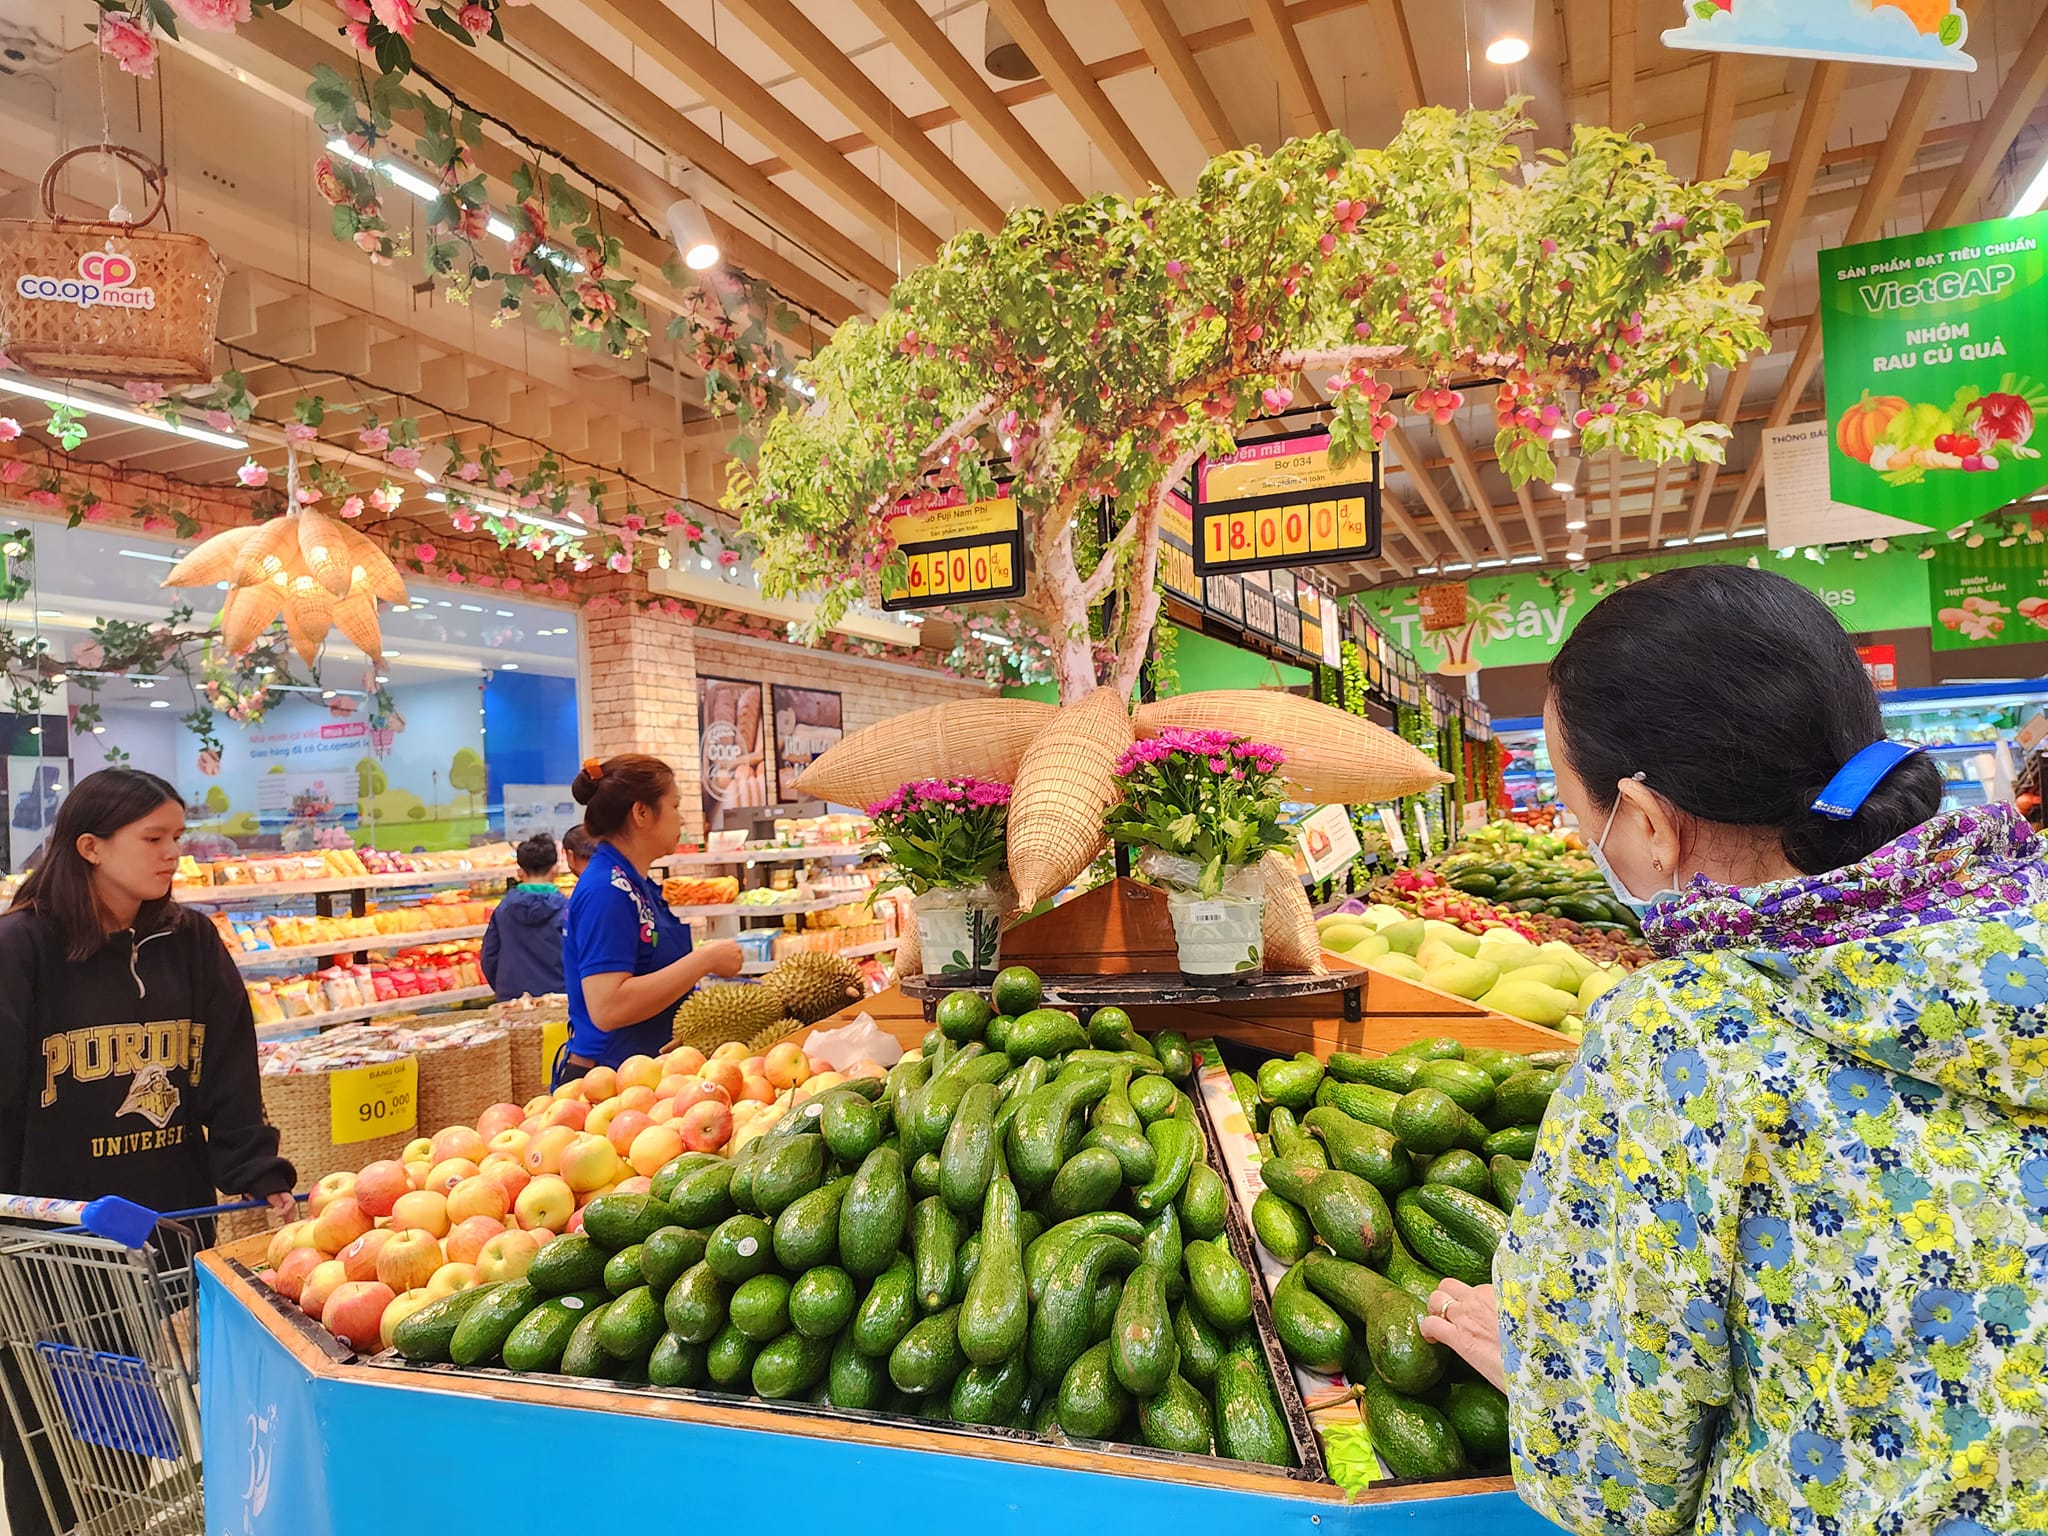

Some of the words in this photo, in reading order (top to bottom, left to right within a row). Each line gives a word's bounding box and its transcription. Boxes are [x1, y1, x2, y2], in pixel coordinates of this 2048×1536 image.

[1837, 266, 1866, 281] SẢN
[1871, 256, 1911, 276] PHẨM
[1915, 253, 1944, 268] ĐẠT
[1948, 247, 1981, 262] TIÊU
[1985, 235, 2037, 256] CHUẨN
[1859, 264, 2015, 312] VietGAP
[1906, 322, 1969, 345] NHÓM
[1873, 352, 1917, 373] RAU
[1923, 344, 1953, 366] CỦ
[1960, 336, 2007, 361] QUẢ
[1772, 432, 1807, 444] THÔNG
[1293, 456, 1312, 467] 034
[938, 512, 951, 522] Fuji
[954, 510, 972, 519] Nam
[1213, 508, 1332, 552] 18.000
[911, 557, 987, 588] 6.500
[91, 1125, 184, 1158] UNIVERSI
